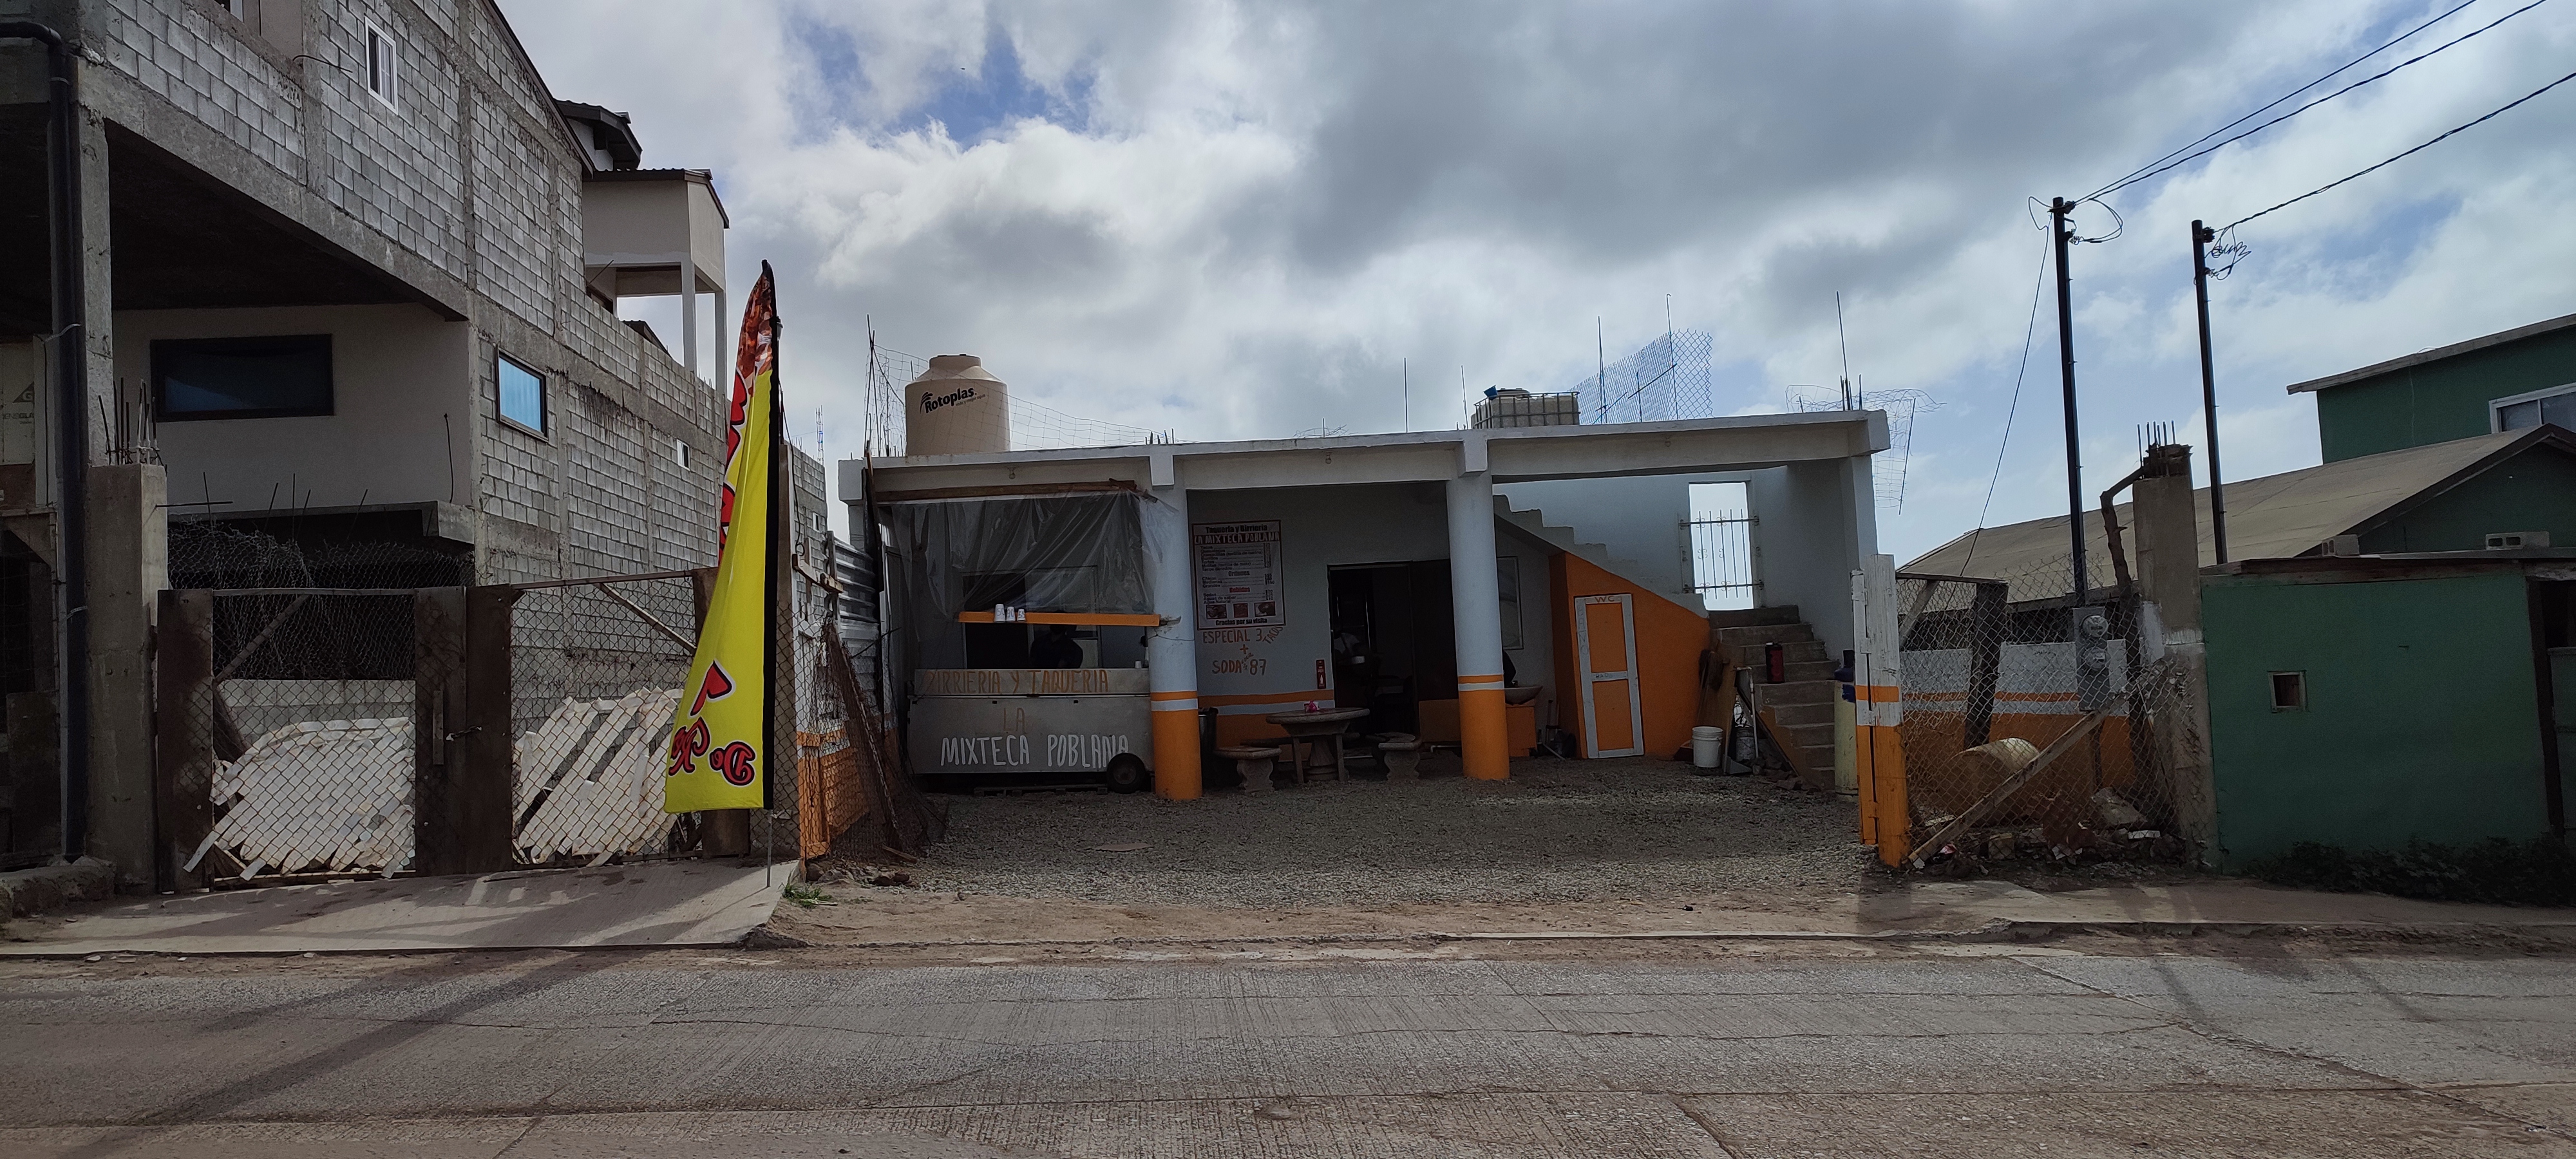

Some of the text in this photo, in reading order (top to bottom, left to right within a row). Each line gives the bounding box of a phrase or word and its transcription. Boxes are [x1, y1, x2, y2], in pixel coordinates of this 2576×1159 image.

[925, 388, 974, 413] Rotoplas
[1195, 532, 1279, 544] LA MIXTECA POBLANA
[1203, 626, 1283, 644] ESPECIAL 3 TACOS
[1212, 659, 1242, 674] SODA
[1250, 659, 1266, 675] 87
[1008, 670, 1019, 693] Y
[1028, 670, 1109, 693] TAQUERIA
[1003, 708, 1026, 733] LA
[940, 734, 1128, 769] MIXTECA POBLANA
